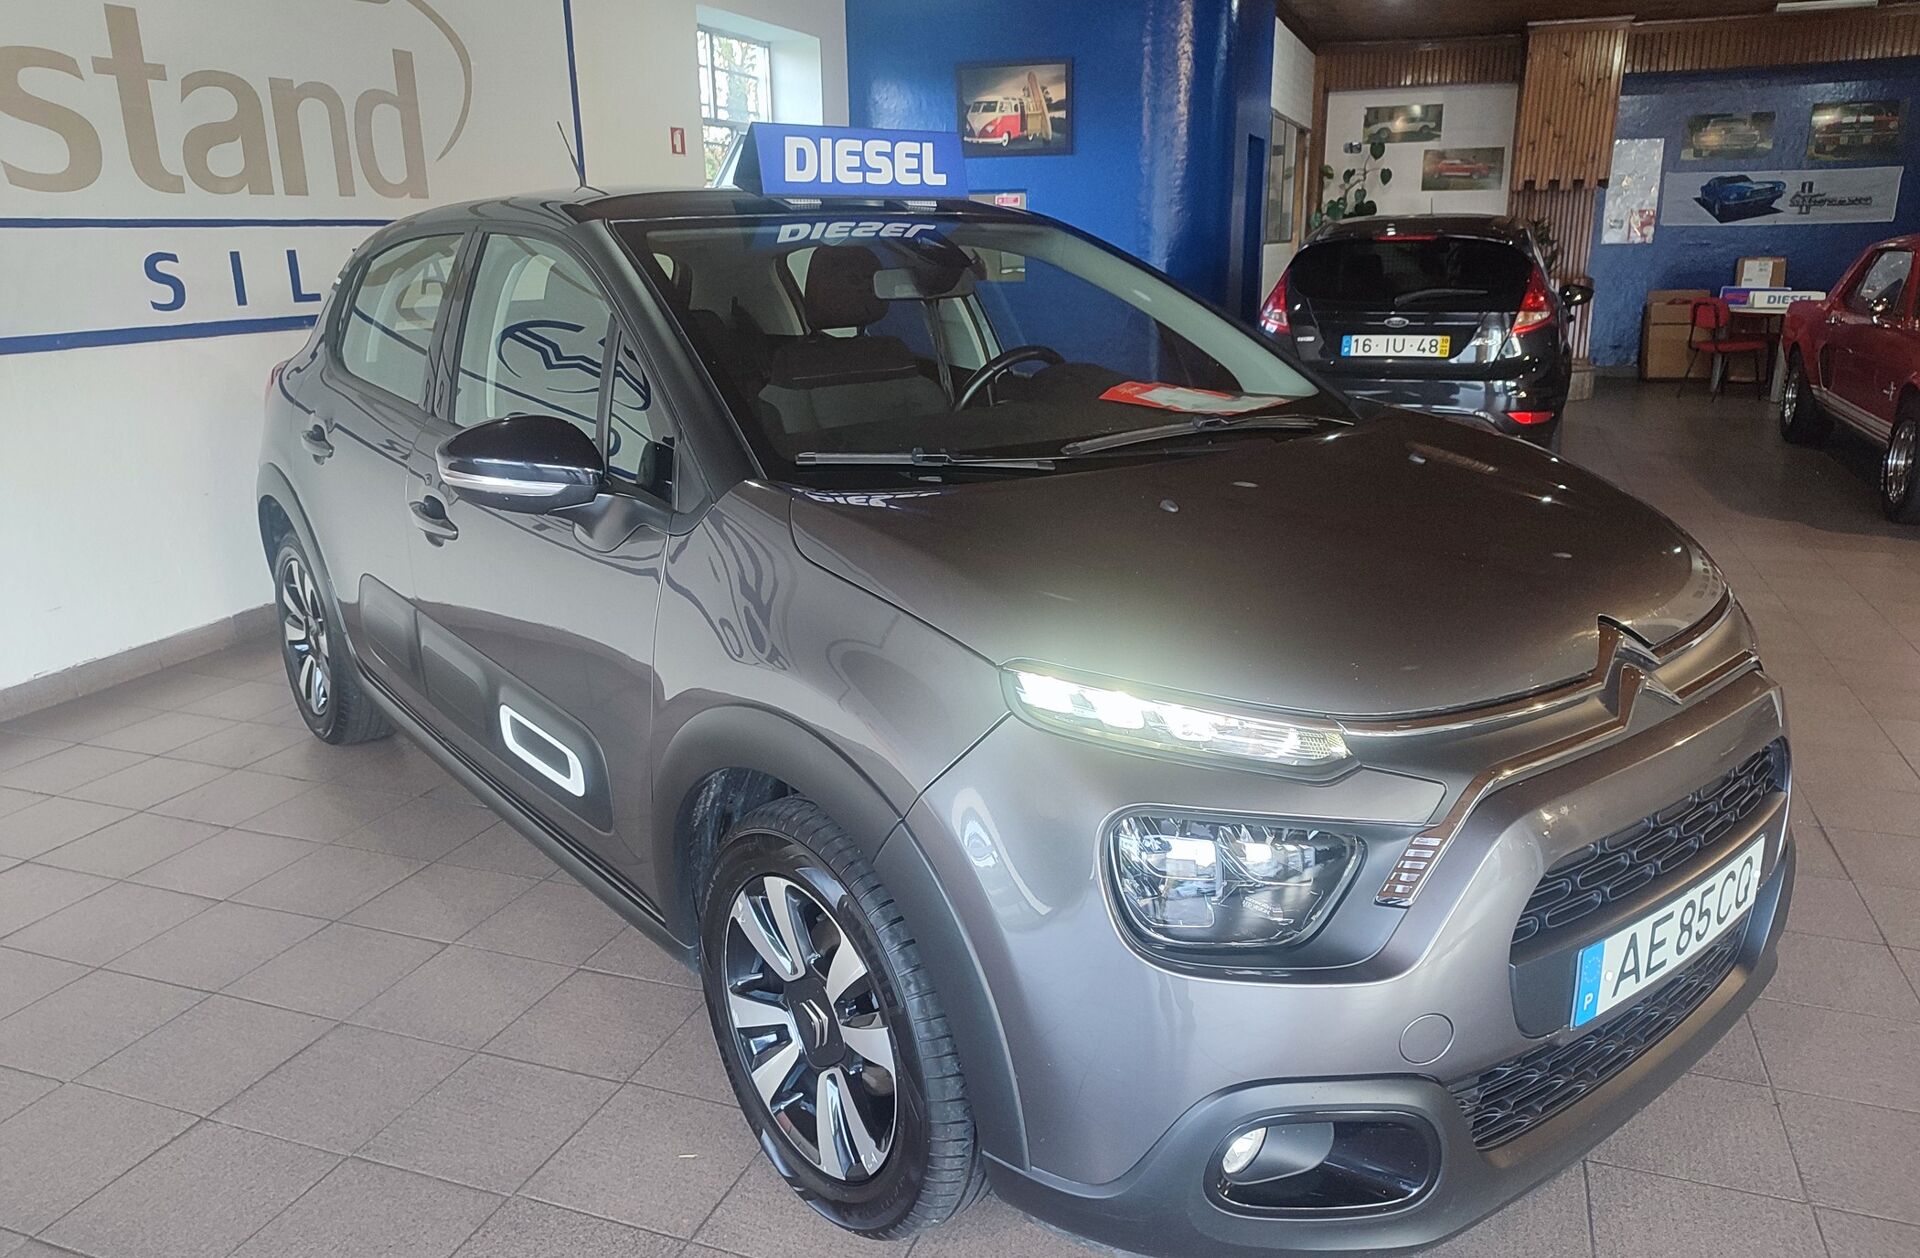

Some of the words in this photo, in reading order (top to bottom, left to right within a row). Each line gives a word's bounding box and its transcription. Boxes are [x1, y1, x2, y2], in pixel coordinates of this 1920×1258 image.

[0, 4, 430, 200] stand
[784, 136, 947, 186] DIESEL
[143, 249, 357, 312] SIL
[1583, 992, 1594, 1011] P
